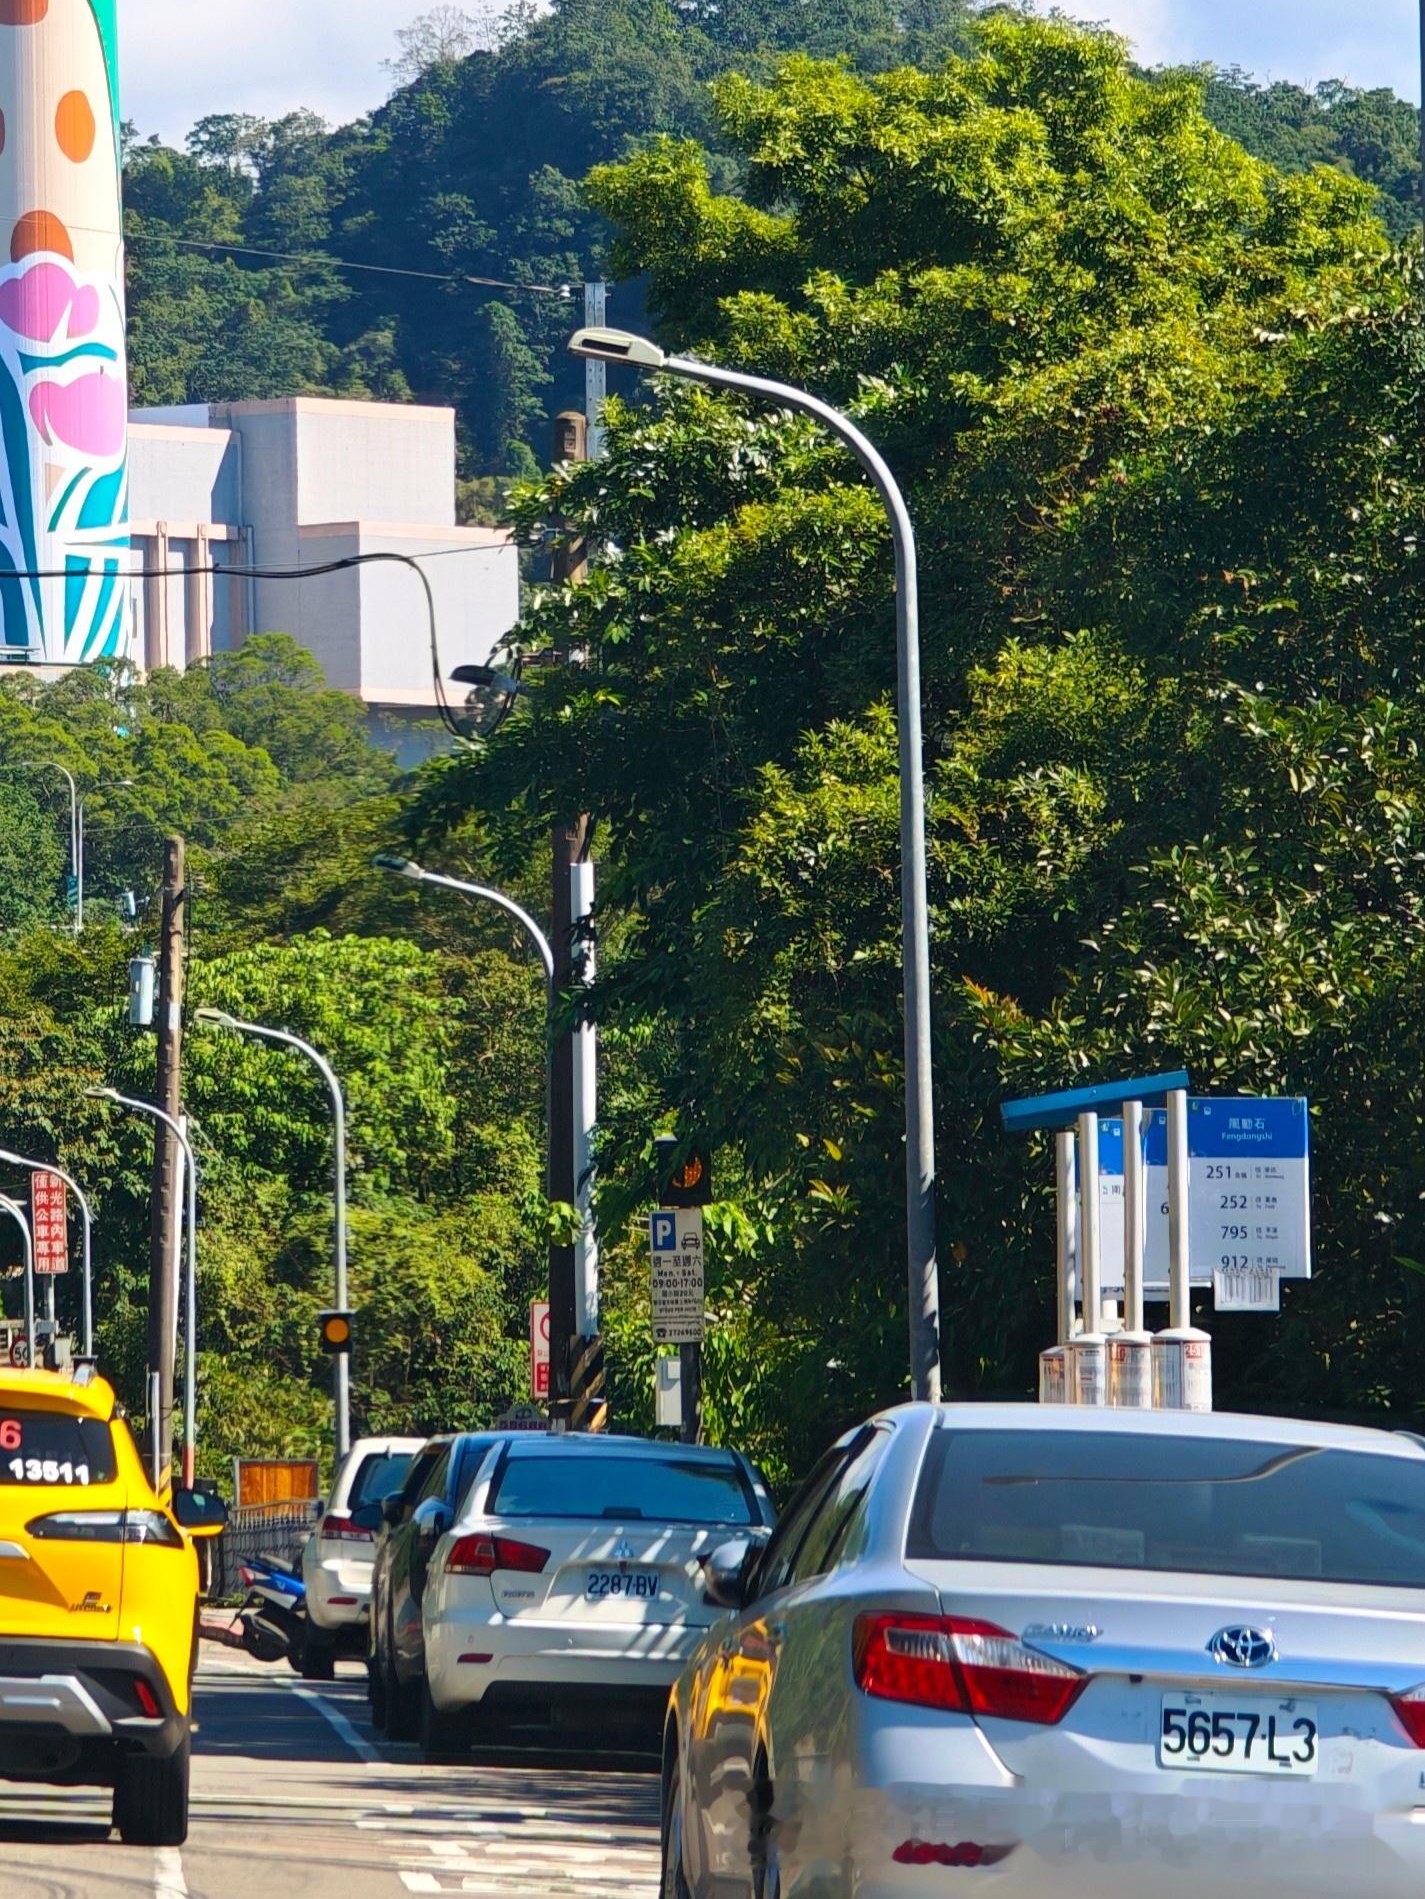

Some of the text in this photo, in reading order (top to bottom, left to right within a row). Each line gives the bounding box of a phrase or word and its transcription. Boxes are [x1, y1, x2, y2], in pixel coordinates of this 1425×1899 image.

[1206, 1165, 1232, 1179] 251
[1220, 1195, 1248, 1209] 252
[1221, 1225, 1248, 1239] 795
[1221, 1255, 1249, 1269] 912
[8, 1457, 90, 1485] 13511
